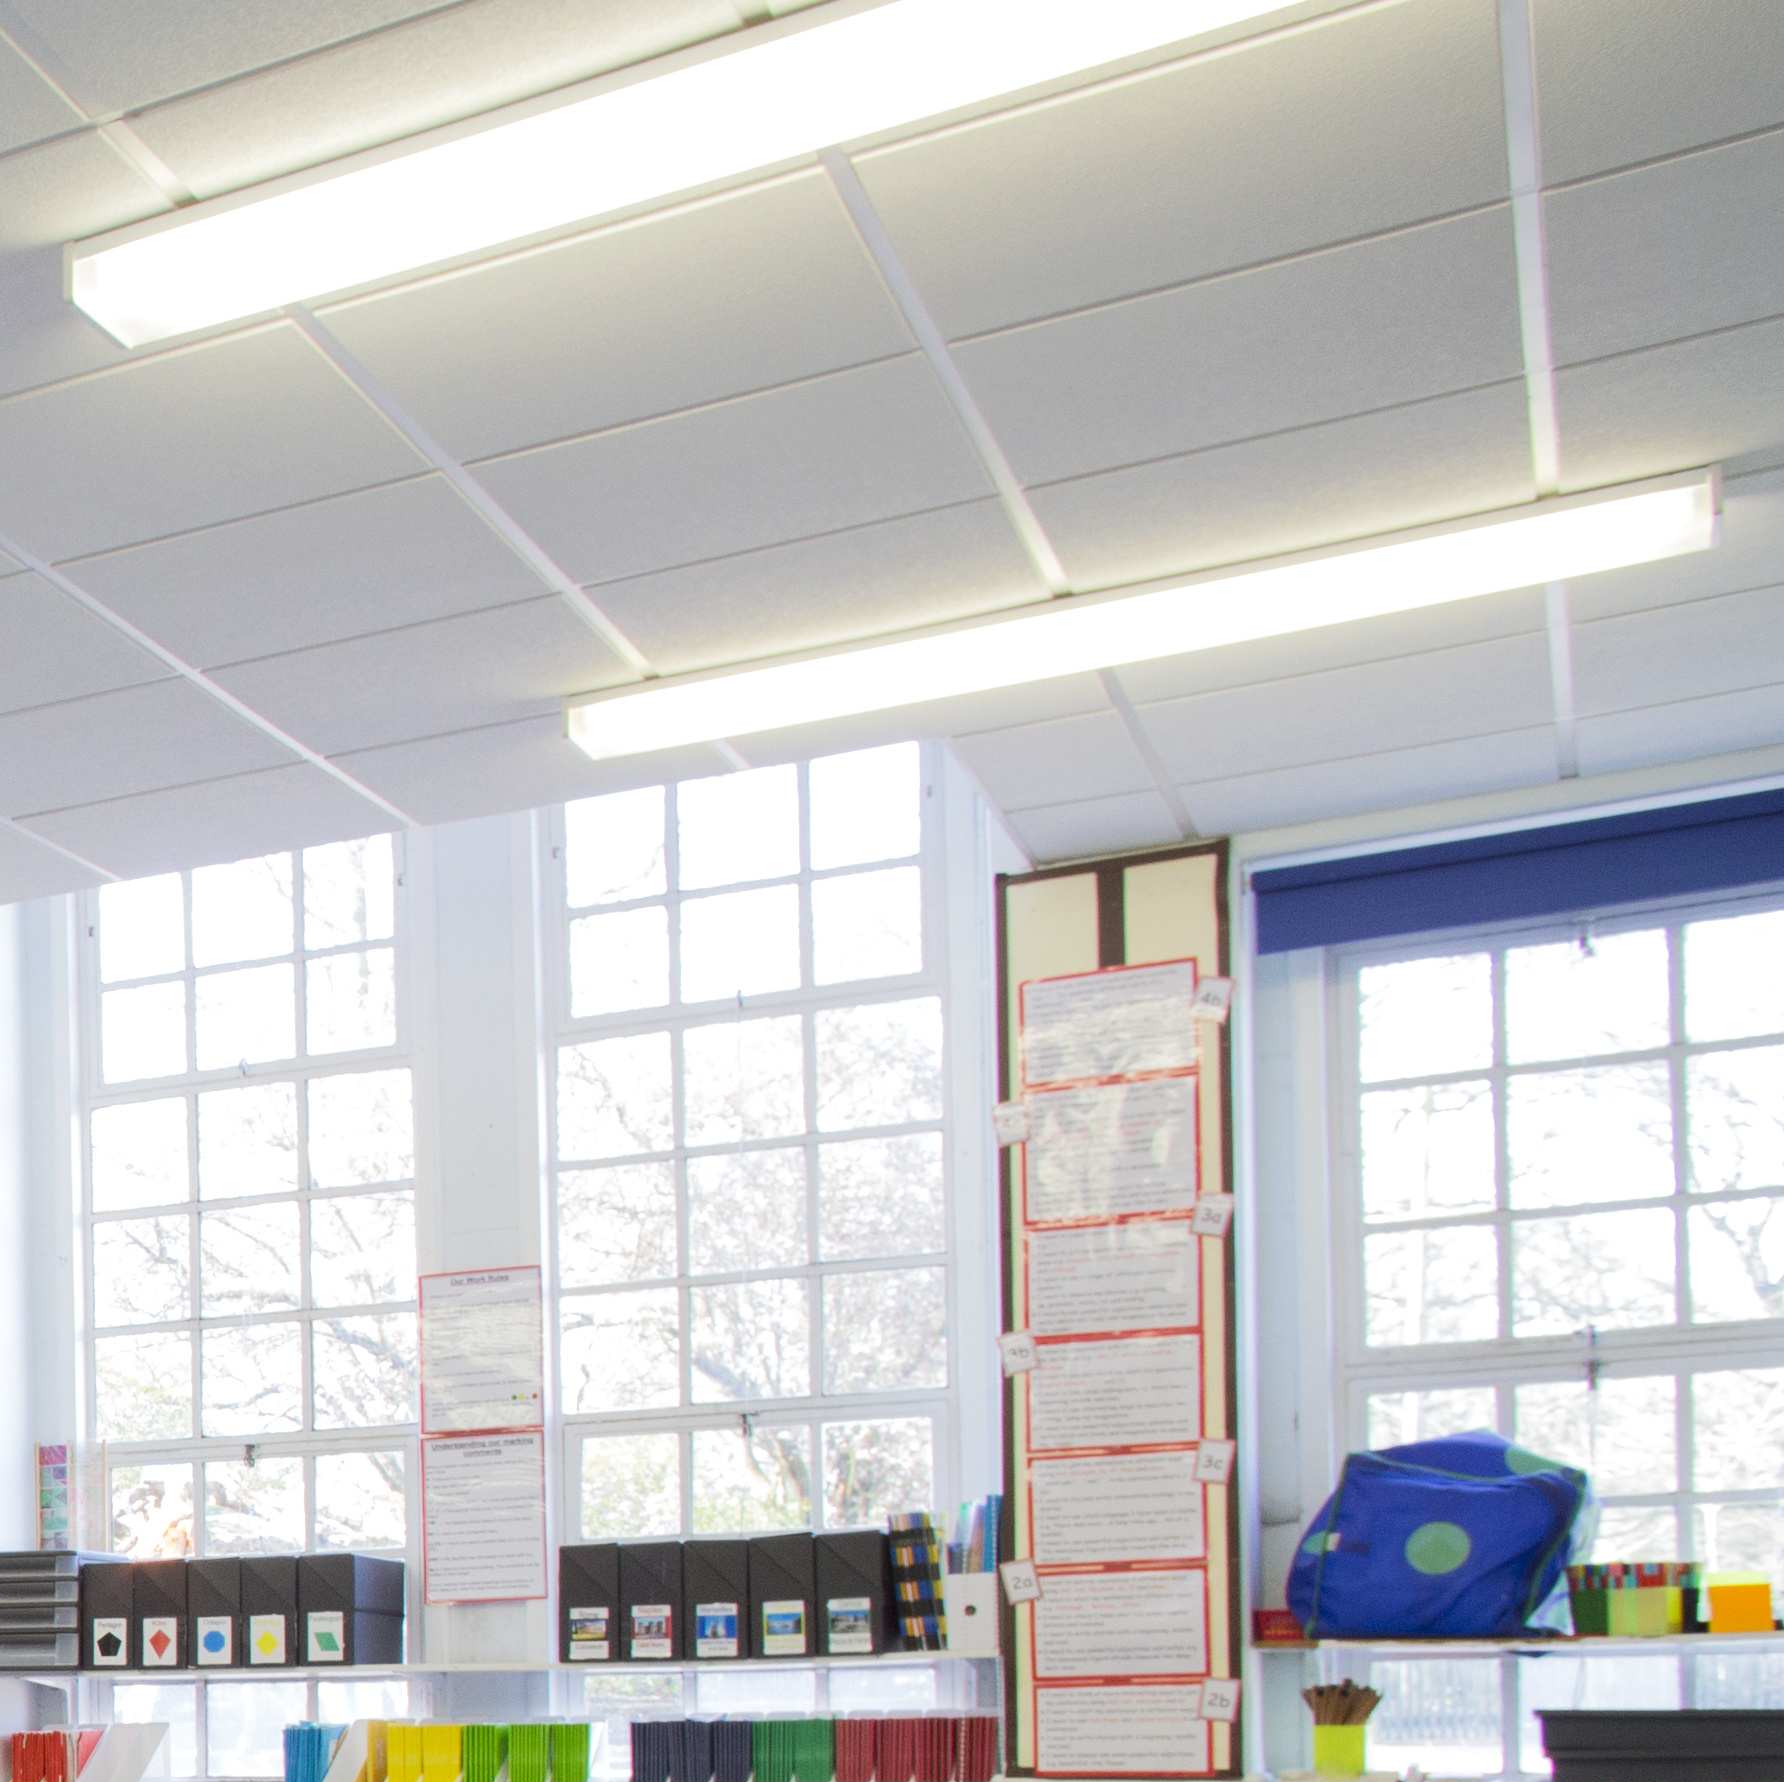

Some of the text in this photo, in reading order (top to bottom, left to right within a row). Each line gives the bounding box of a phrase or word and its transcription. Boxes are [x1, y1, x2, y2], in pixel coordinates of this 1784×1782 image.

[1201, 1453, 1223, 1470] 3c
[1012, 1576, 1033, 1590] 2a
[1207, 1692, 1230, 1708] 2b
